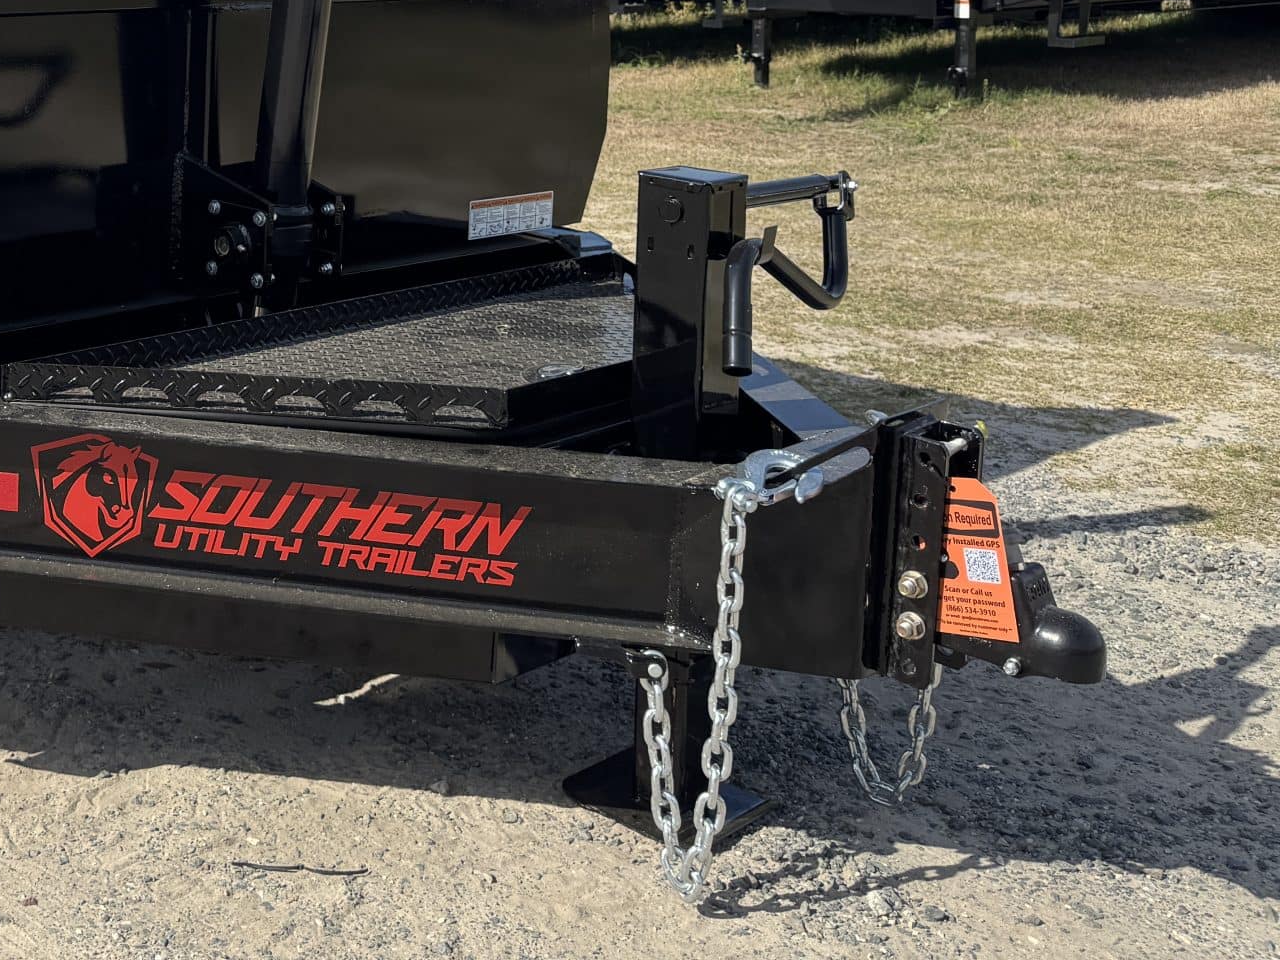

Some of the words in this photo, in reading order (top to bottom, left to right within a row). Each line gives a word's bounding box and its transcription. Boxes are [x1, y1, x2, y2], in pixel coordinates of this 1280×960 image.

[148, 469, 533, 556] SOUTHERN
[954, 512, 992, 526] Required
[952, 537, 985, 547] Installed
[986, 540, 1000, 548] GPS
[153, 523, 302, 561] UTILITY
[317, 541, 519, 586] TRAILERS
[944, 585, 960, 593] Scan
[970, 588, 983, 596] Call
[973, 598, 1006, 608] password
